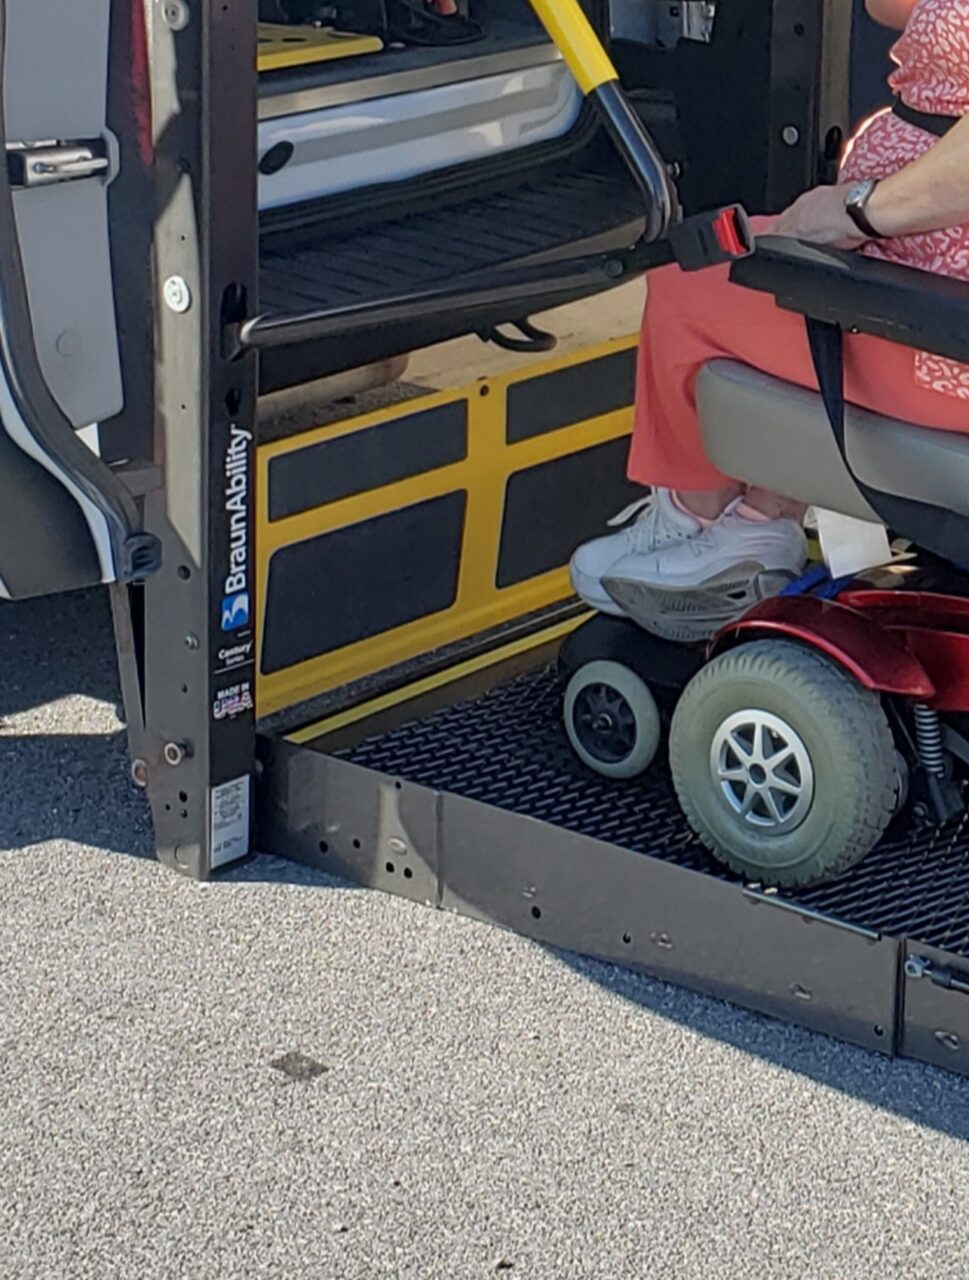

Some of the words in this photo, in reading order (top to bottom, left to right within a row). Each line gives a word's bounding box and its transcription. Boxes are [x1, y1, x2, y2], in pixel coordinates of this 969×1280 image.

[225, 427, 253, 595] BraunAbility
[218, 640, 252, 659] Century
[217, 684, 241, 699] MADE
[241, 681, 250, 691] IN
